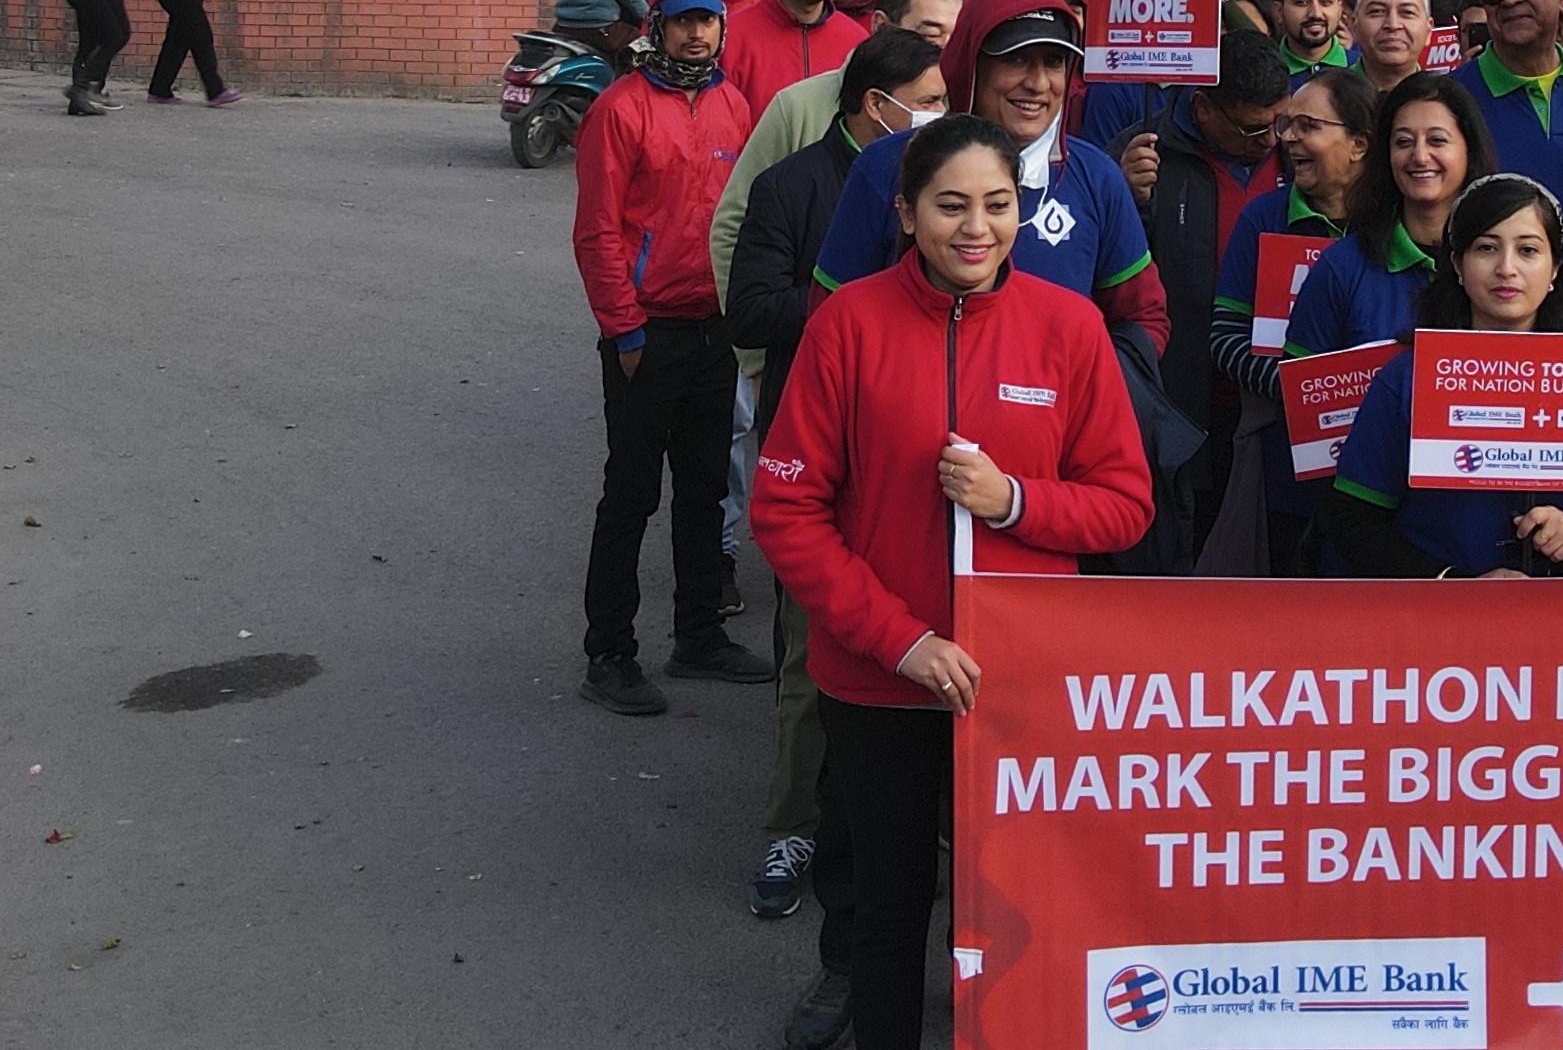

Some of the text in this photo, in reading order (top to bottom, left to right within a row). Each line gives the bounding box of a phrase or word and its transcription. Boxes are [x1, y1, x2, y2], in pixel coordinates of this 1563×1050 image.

[1120, 50, 1194, 62] Global IME Bank
[1436, 358, 1536, 377] GROWING
[1302, 382, 1371, 406] FOR NATI
[1435, 376, 1468, 392] FOR
[1472, 378, 1535, 394] NATION
[1484, 448, 1532, 462] Global
[1065, 666, 1532, 731] WALKATHON
[995, 752, 1212, 814] MARK
[1226, 749, 1366, 806] THE
[1145, 830, 1286, 888] THE
[1172, 962, 1470, 998] Global IME Bank
